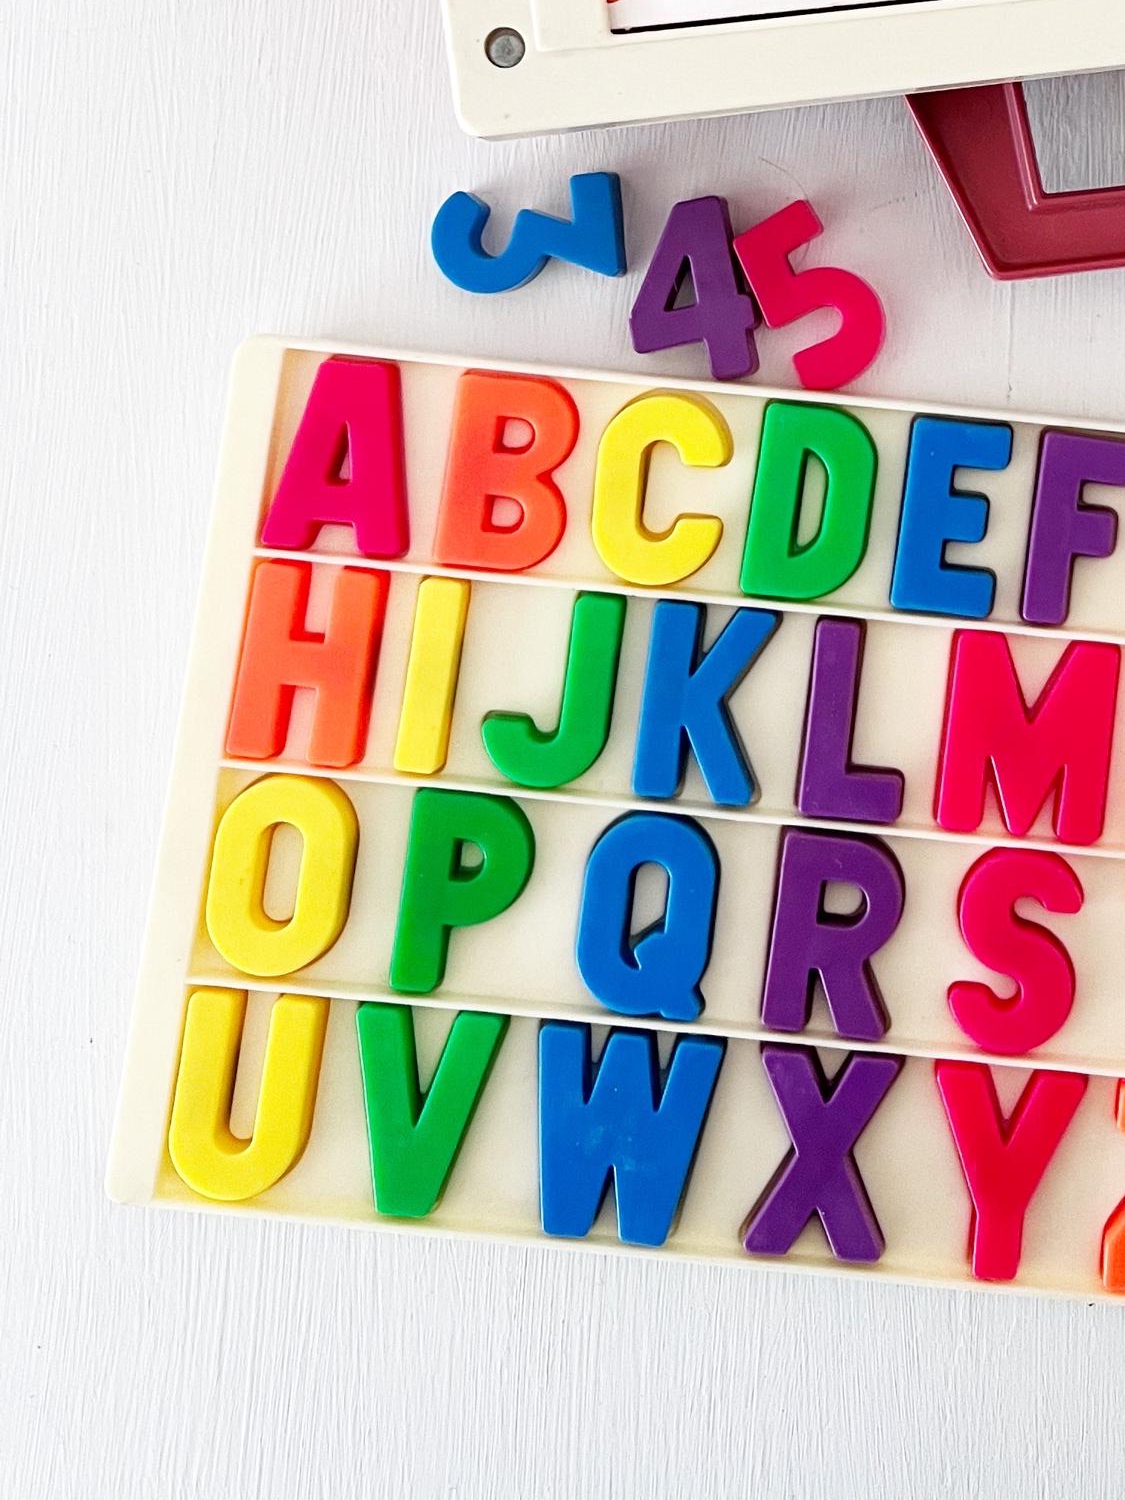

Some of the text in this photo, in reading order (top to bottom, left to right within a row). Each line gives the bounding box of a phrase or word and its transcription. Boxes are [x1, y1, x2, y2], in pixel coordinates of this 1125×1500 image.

[629, 195, 762, 380] 4
[732, 199, 887, 392] 5
[260, 353, 412, 560] A
[434, 369, 579, 576] B
[591, 391, 734, 588] C
[739, 399, 880, 601] D
[889, 415, 1012, 619] E
[224, 555, 387, 773] H
[481, 591, 628, 790] J
[633, 600, 781, 808] K
[800, 617, 906, 824] L
[933, 627, 1123, 847] M
[389, 787, 538, 994] P
[576, 810, 722, 1023] Q
[761, 824, 906, 1043] R
[947, 847, 1086, 1058] S
[158, 988, 328, 1207] U
[356, 1001, 514, 1220] V
[537, 1020, 728, 1250] W
[742, 1047, 905, 1264] X
[933, 1057, 1090, 1284] Y
